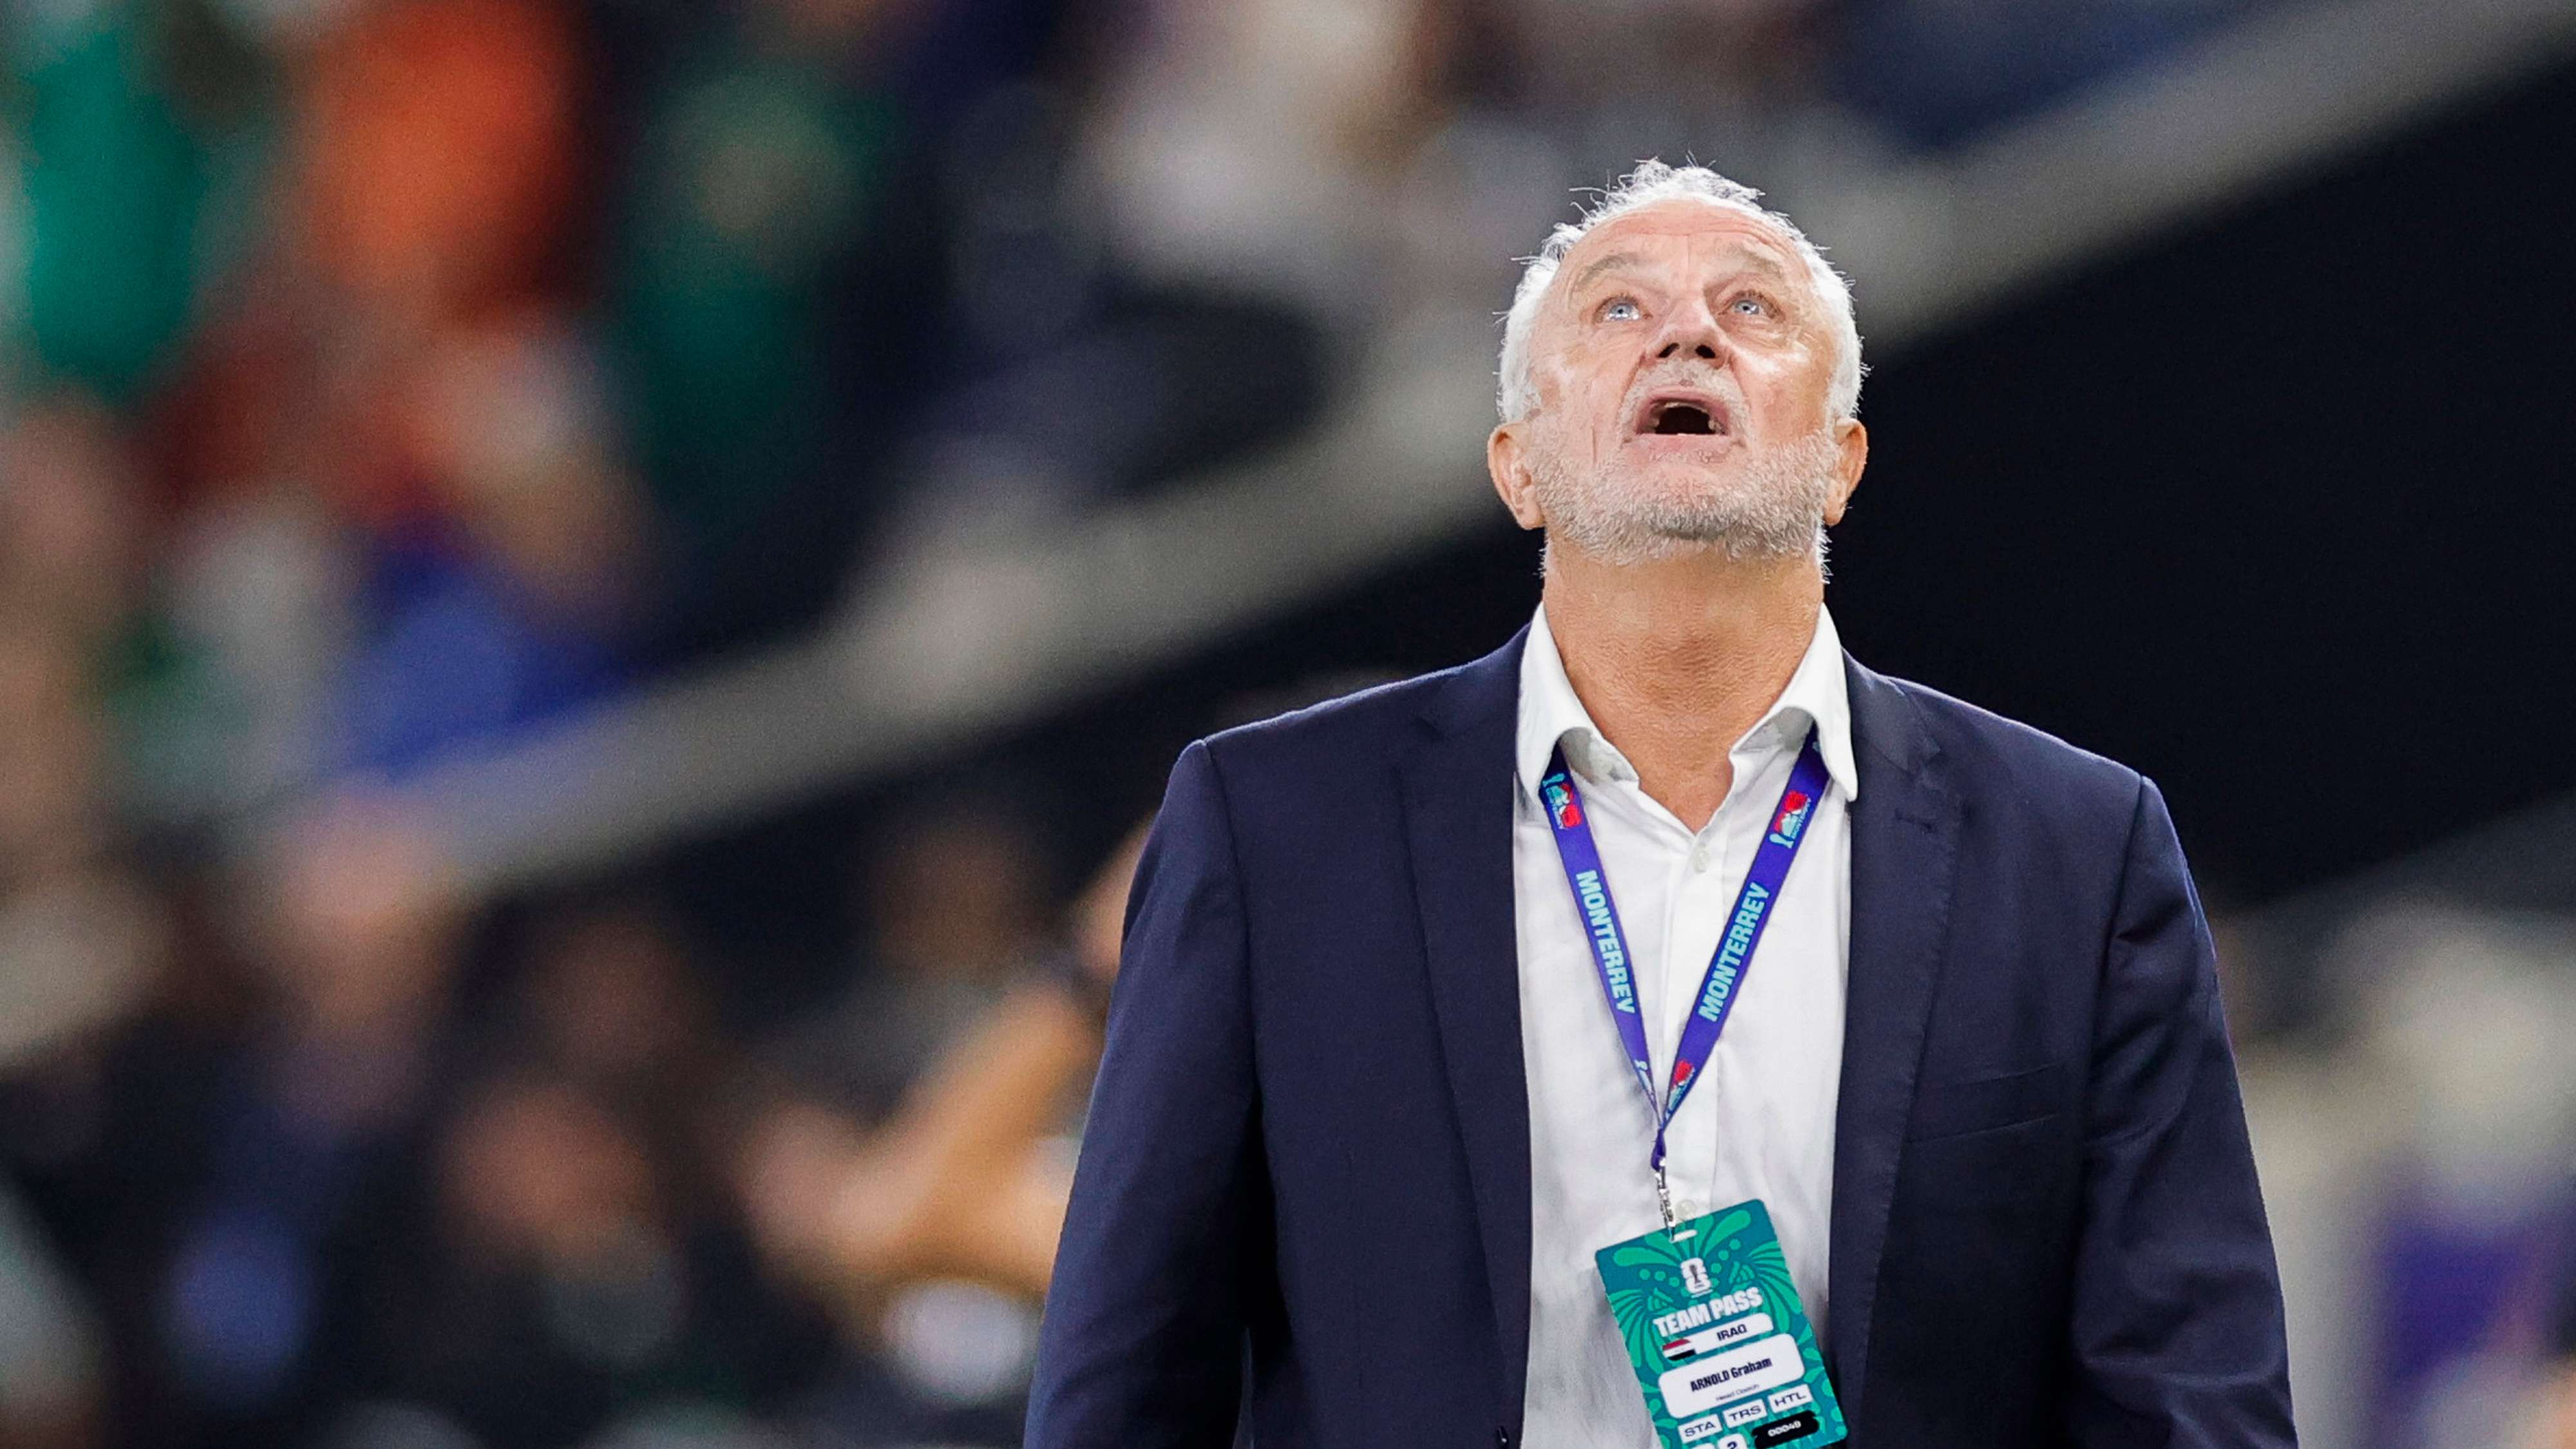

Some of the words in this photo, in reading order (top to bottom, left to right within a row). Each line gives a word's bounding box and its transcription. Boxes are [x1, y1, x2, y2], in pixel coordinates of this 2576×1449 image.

[1577, 870, 1635, 1014] MONTERREY
[1698, 882, 1769, 1022] MONTERREY
[1653, 1303, 1711, 1337] TEAM
[1709, 1287, 1763, 1320] PASS
[1717, 1323, 1747, 1341] IRAQ
[1690, 1370, 1730, 1392] ARNOLD
[1730, 1358, 1772, 1378] Graham
[1774, 1392, 1806, 1406] HTL
[1729, 1405, 1761, 1422] TRS
[1685, 1421, 1716, 1437] STA
